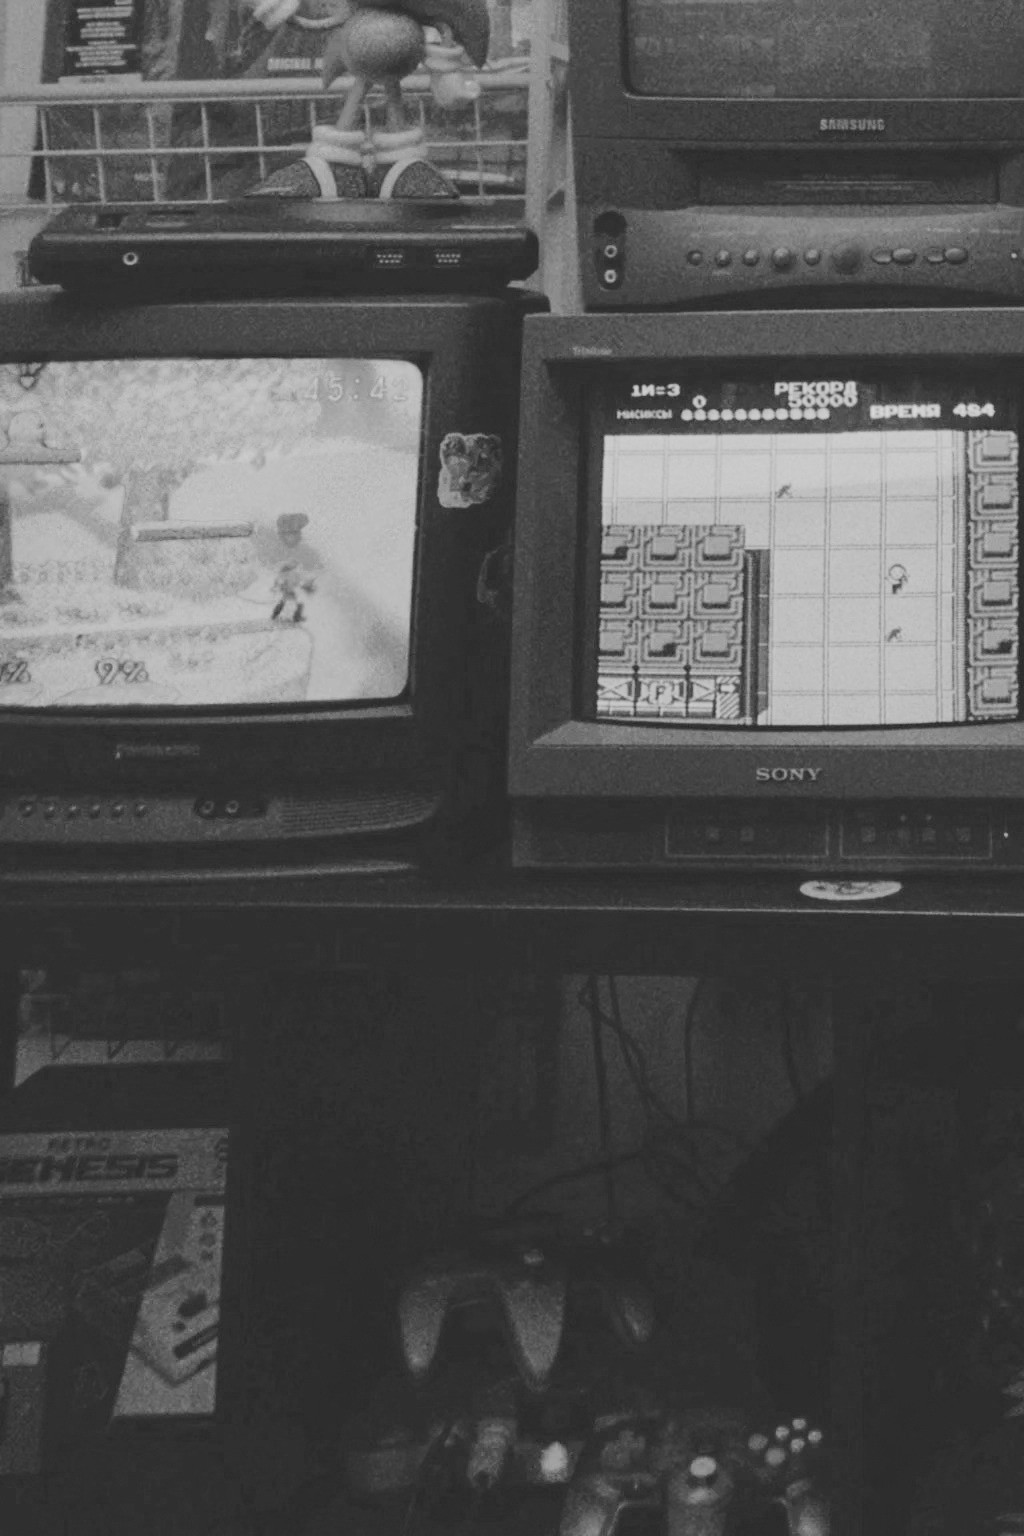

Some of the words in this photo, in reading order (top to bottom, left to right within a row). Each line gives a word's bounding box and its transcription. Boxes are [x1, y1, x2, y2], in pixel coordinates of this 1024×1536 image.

[819, 117, 887, 132] SAMSUNG
[631, 382, 681, 398] 1И=3
[773, 381, 859, 397] РЕКОРД
[787, 393, 859, 409] 50000
[868, 403, 942, 420] ВРЕМЯ
[93, 657, 151, 686] 9%
[755, 767, 823, 782] SONY
